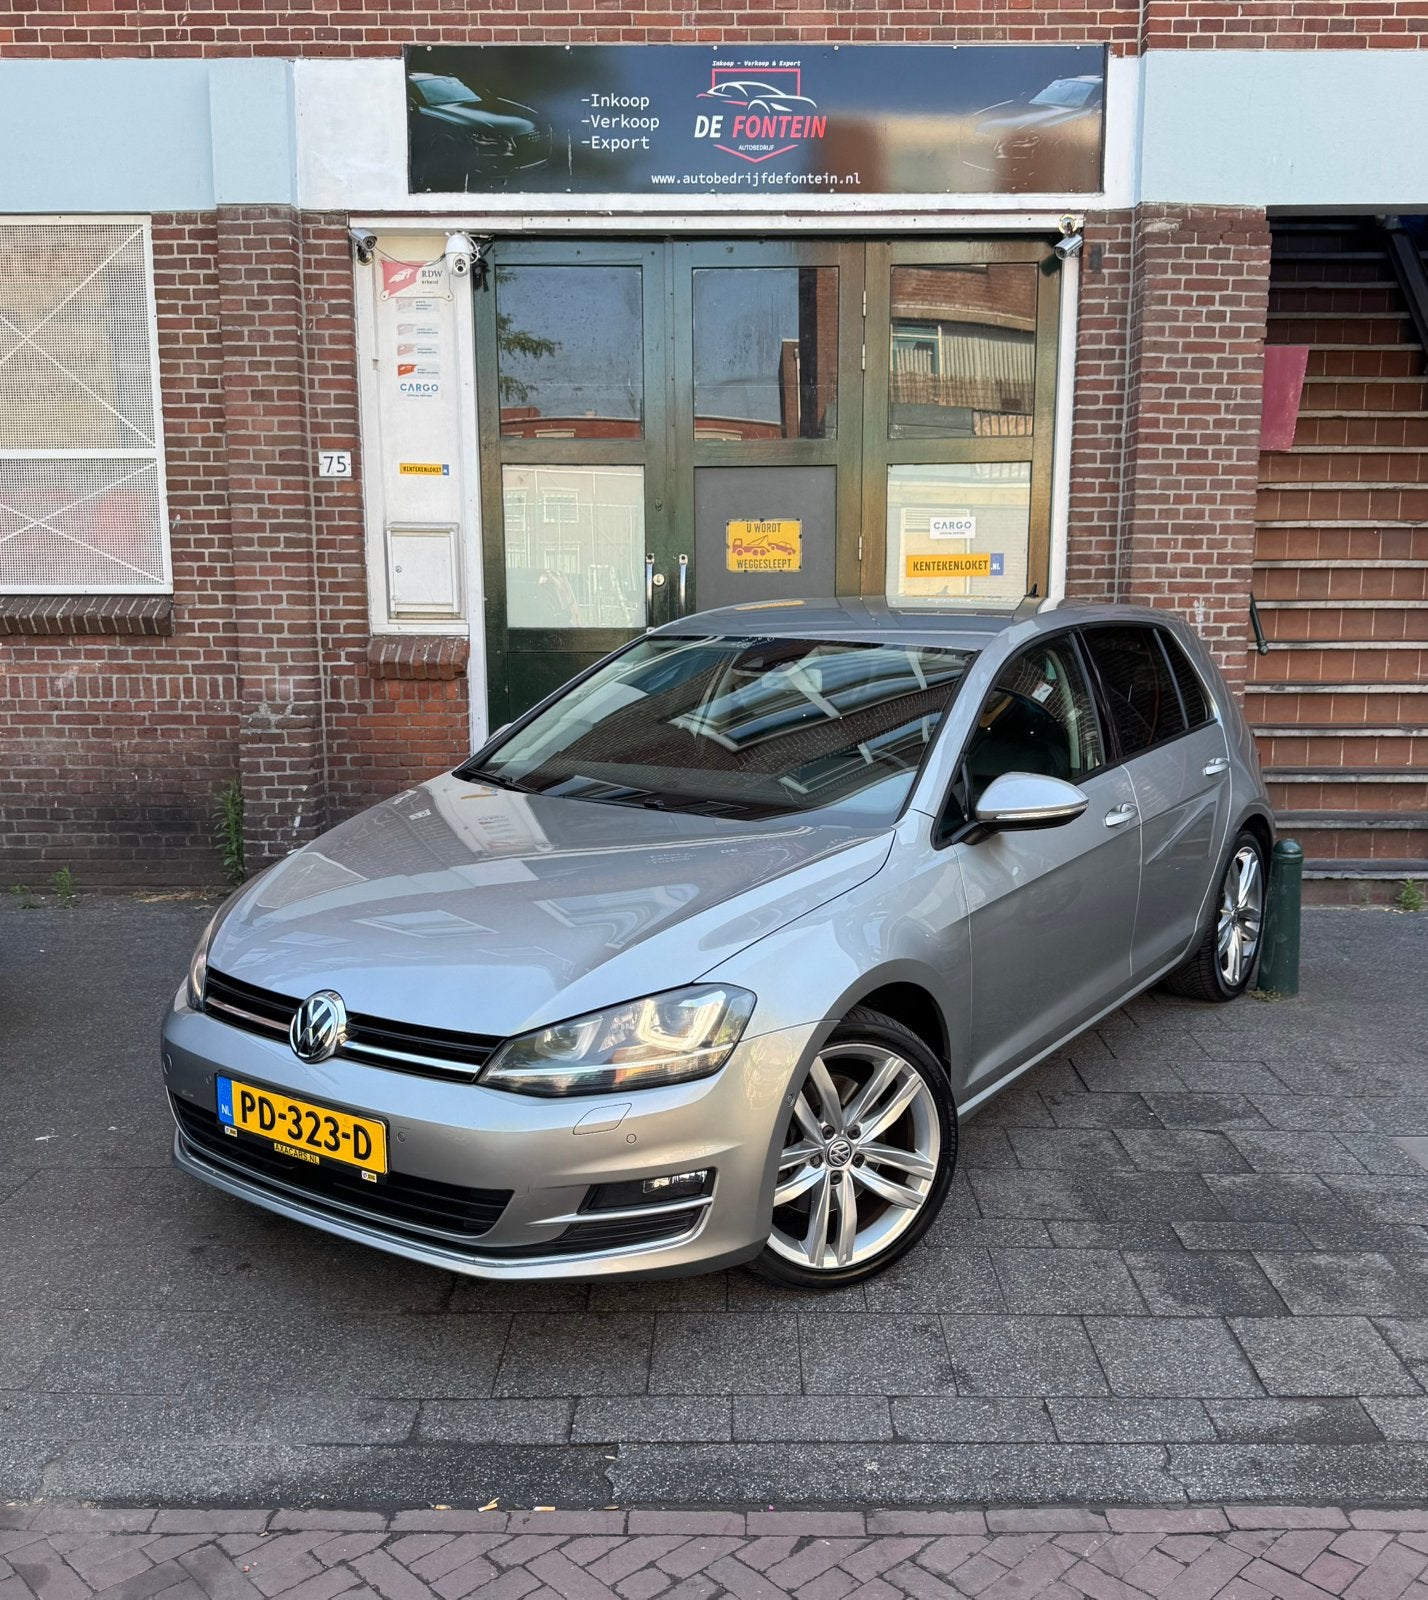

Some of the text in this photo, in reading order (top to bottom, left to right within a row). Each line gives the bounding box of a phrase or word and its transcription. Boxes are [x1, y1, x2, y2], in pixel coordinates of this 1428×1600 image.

[581, 92, 650, 111] -Inkoop
[581, 113, 660, 132] -Verkoop
[694, 115, 827, 138] DE FONTEIN
[581, 135, 650, 153] -Export
[651, 172, 861, 187] www.autobedrijfdefontein.nl
[421, 270, 443, 278] RDW
[400, 383, 439, 392] CARGO
[323, 456, 347, 473] 75
[746, 523, 781, 533] U WORDT
[933, 521, 972, 530] CARGO
[736, 559, 791, 569] WEGGESLEEPT
[913, 560, 988, 571] KENTEKENLOKET
[221, 1103, 232, 1117] NL
[240, 1090, 372, 1161] PD-323-D
